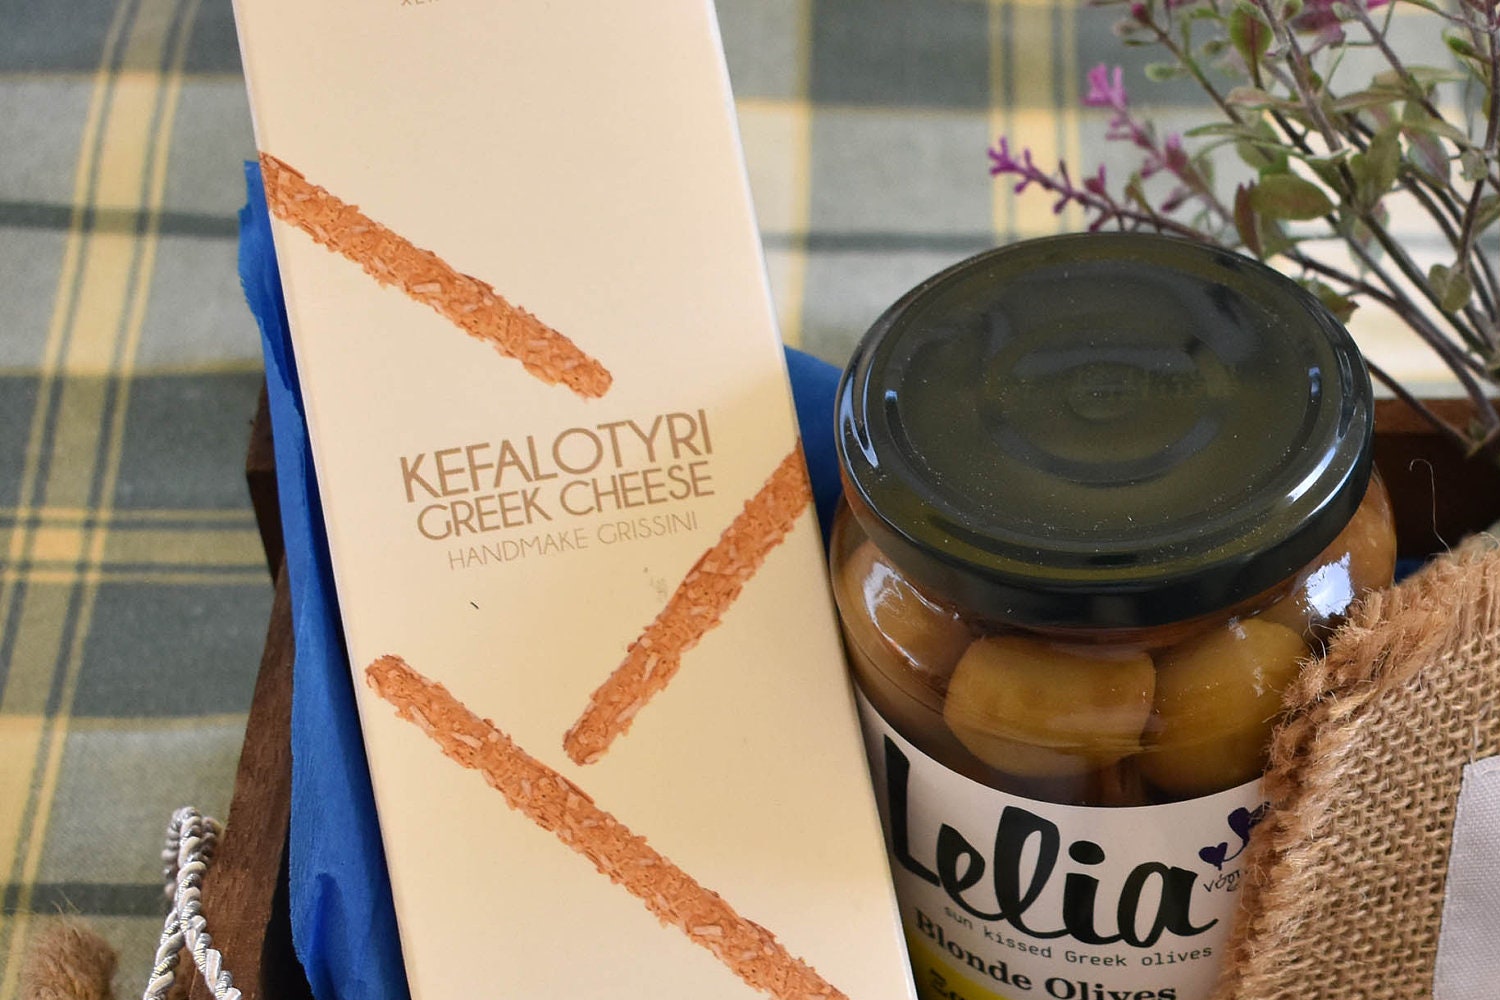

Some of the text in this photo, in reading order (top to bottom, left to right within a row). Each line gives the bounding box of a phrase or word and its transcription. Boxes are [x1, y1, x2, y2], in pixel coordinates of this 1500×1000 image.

[399, 408, 713, 504] KEFALOTYRI
[416, 459, 716, 541] GREEK CHEESE
[447, 510, 700, 572] HANDMAKE GRISSINI
[882, 732, 1219, 949] Lelia
[914, 906, 1034, 992] Blonde
[944, 905, 1213, 968] sun kissed Greek olives
